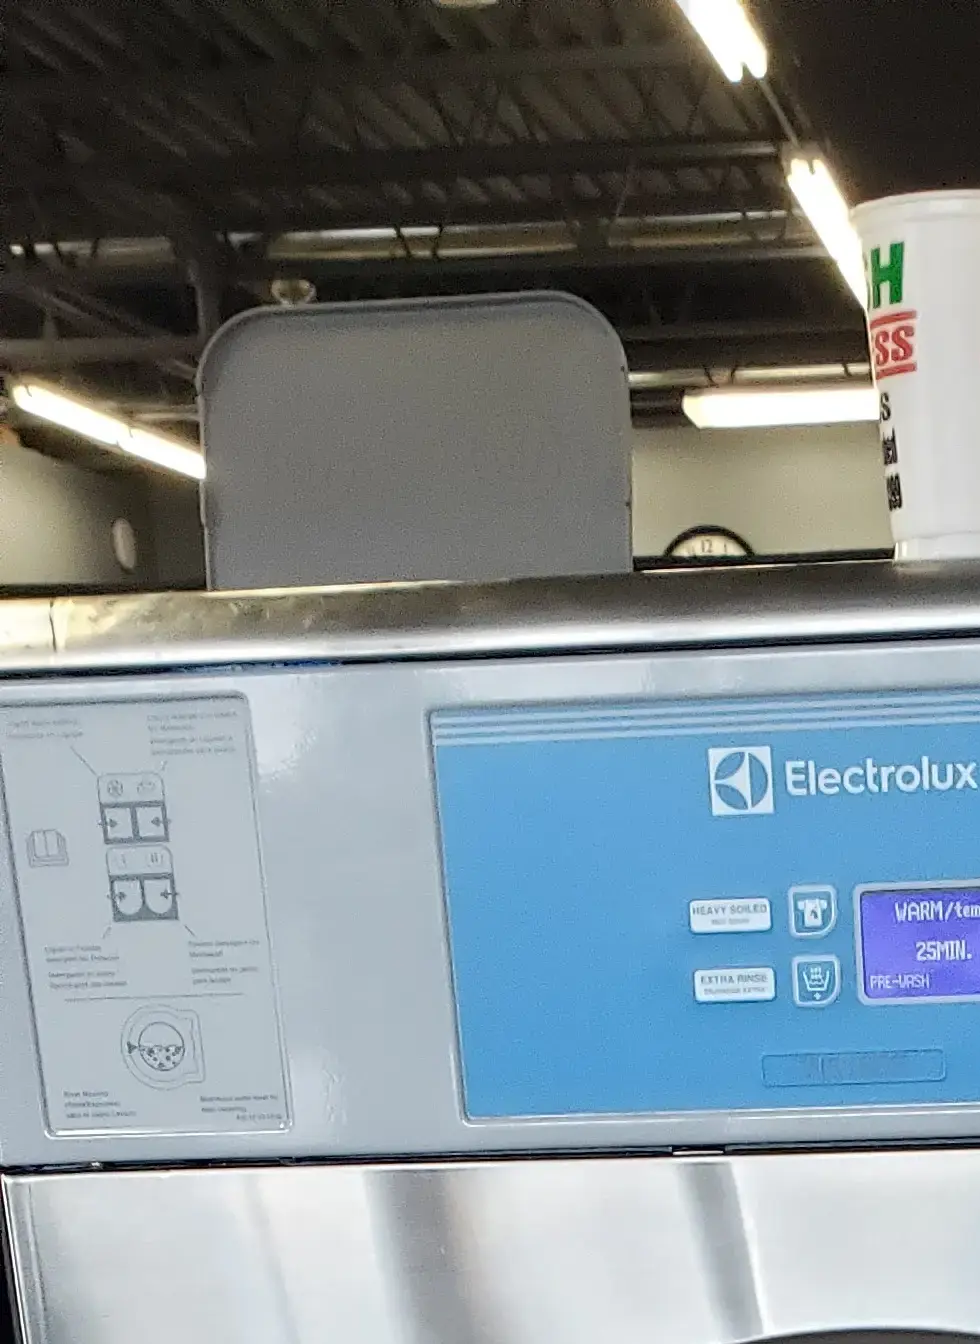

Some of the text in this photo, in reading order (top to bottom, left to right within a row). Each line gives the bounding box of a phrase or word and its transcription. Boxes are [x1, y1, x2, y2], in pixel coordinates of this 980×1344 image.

[867, 241, 904, 308] H
[701, 539, 713, 553] 12
[785, 756, 978, 796] Electrolux
[693, 904, 768, 916] HEAVY SOILED
[916, 939, 973, 962] 25MIN.
[700, 974, 768, 985] EXTRA RINSE
[870, 974, 930, 989] PRE-WASH
